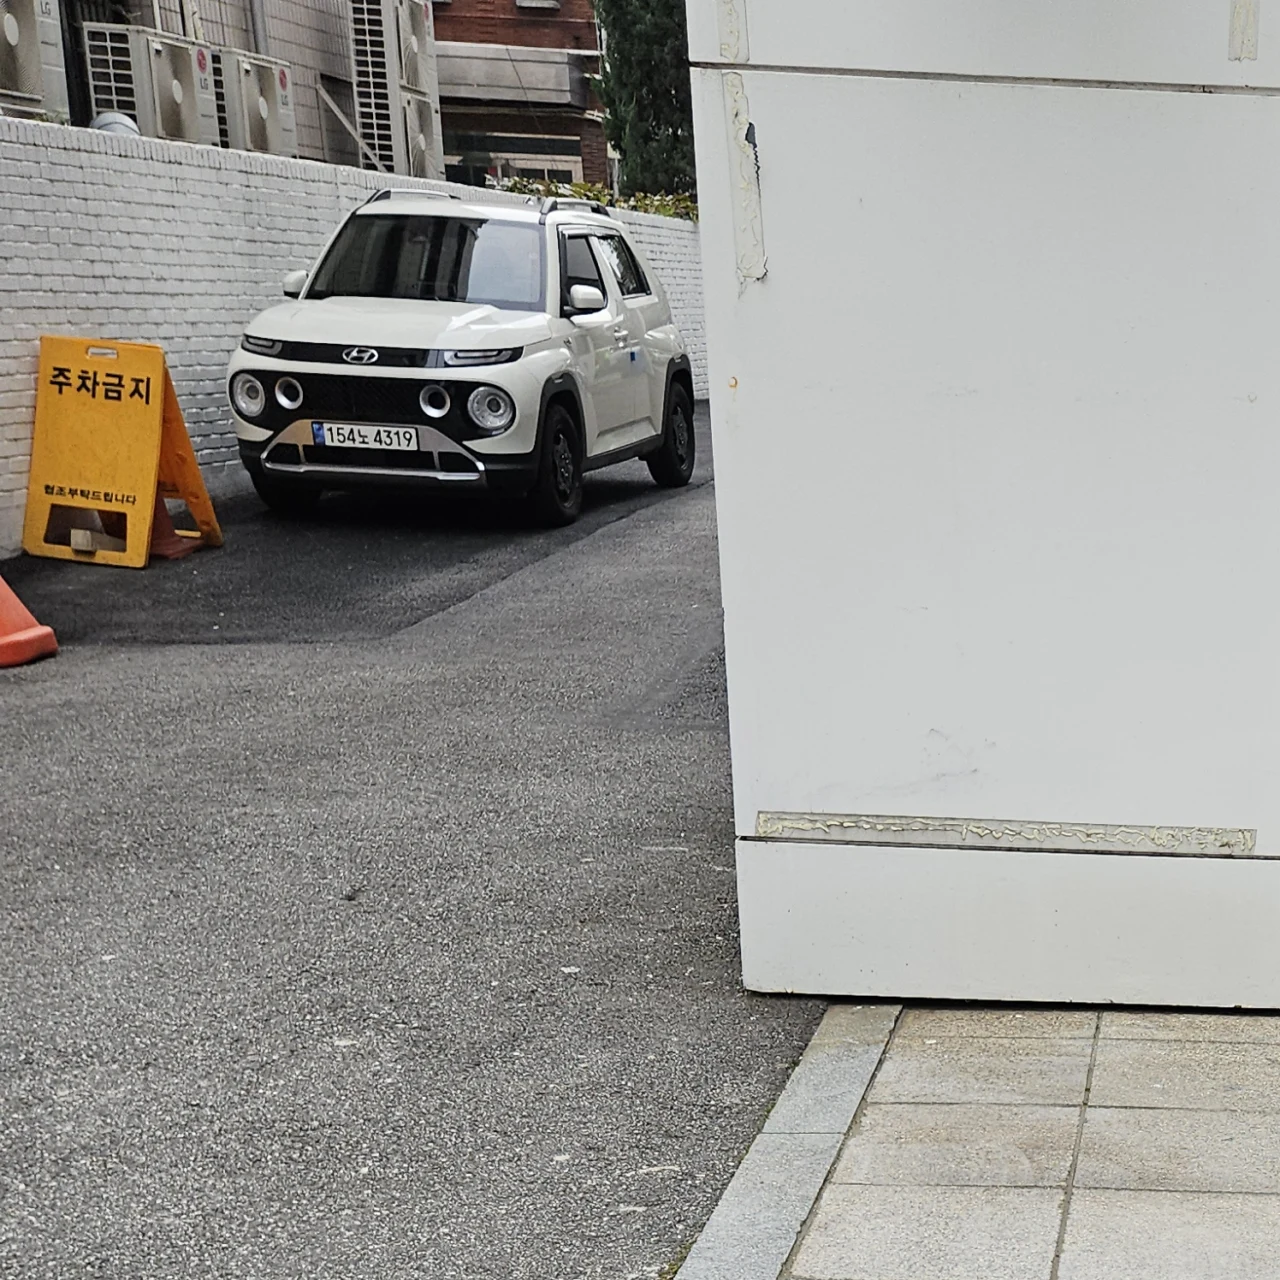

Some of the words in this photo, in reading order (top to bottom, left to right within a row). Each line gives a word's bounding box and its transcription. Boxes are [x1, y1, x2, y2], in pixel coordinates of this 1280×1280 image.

[49, 366, 151, 406] 주차금지
[326, 426, 370, 445] 154노
[373, 429, 413, 448] 4319
